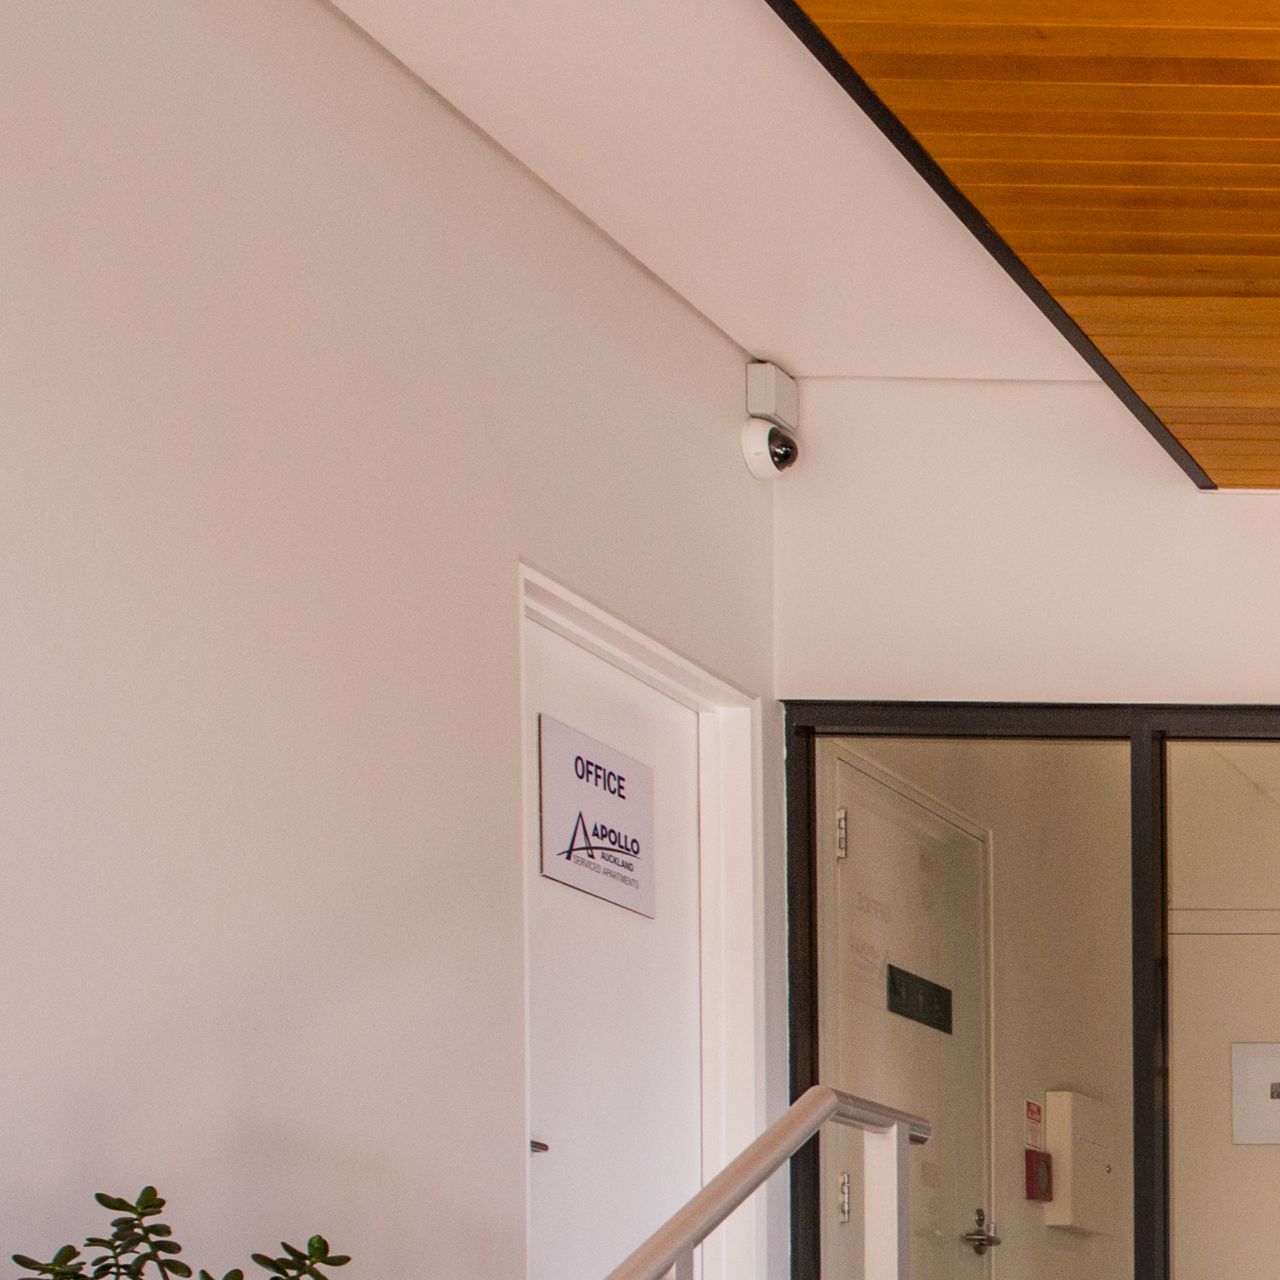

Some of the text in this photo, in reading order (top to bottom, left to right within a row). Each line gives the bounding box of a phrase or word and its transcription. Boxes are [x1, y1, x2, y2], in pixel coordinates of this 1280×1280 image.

[574, 755, 627, 800] OFFICE
[592, 822, 640, 856] APOLLO
[573, 853, 640, 890] SERVICED APARTMENTS
[600, 851, 634, 872] AUCKLAND
